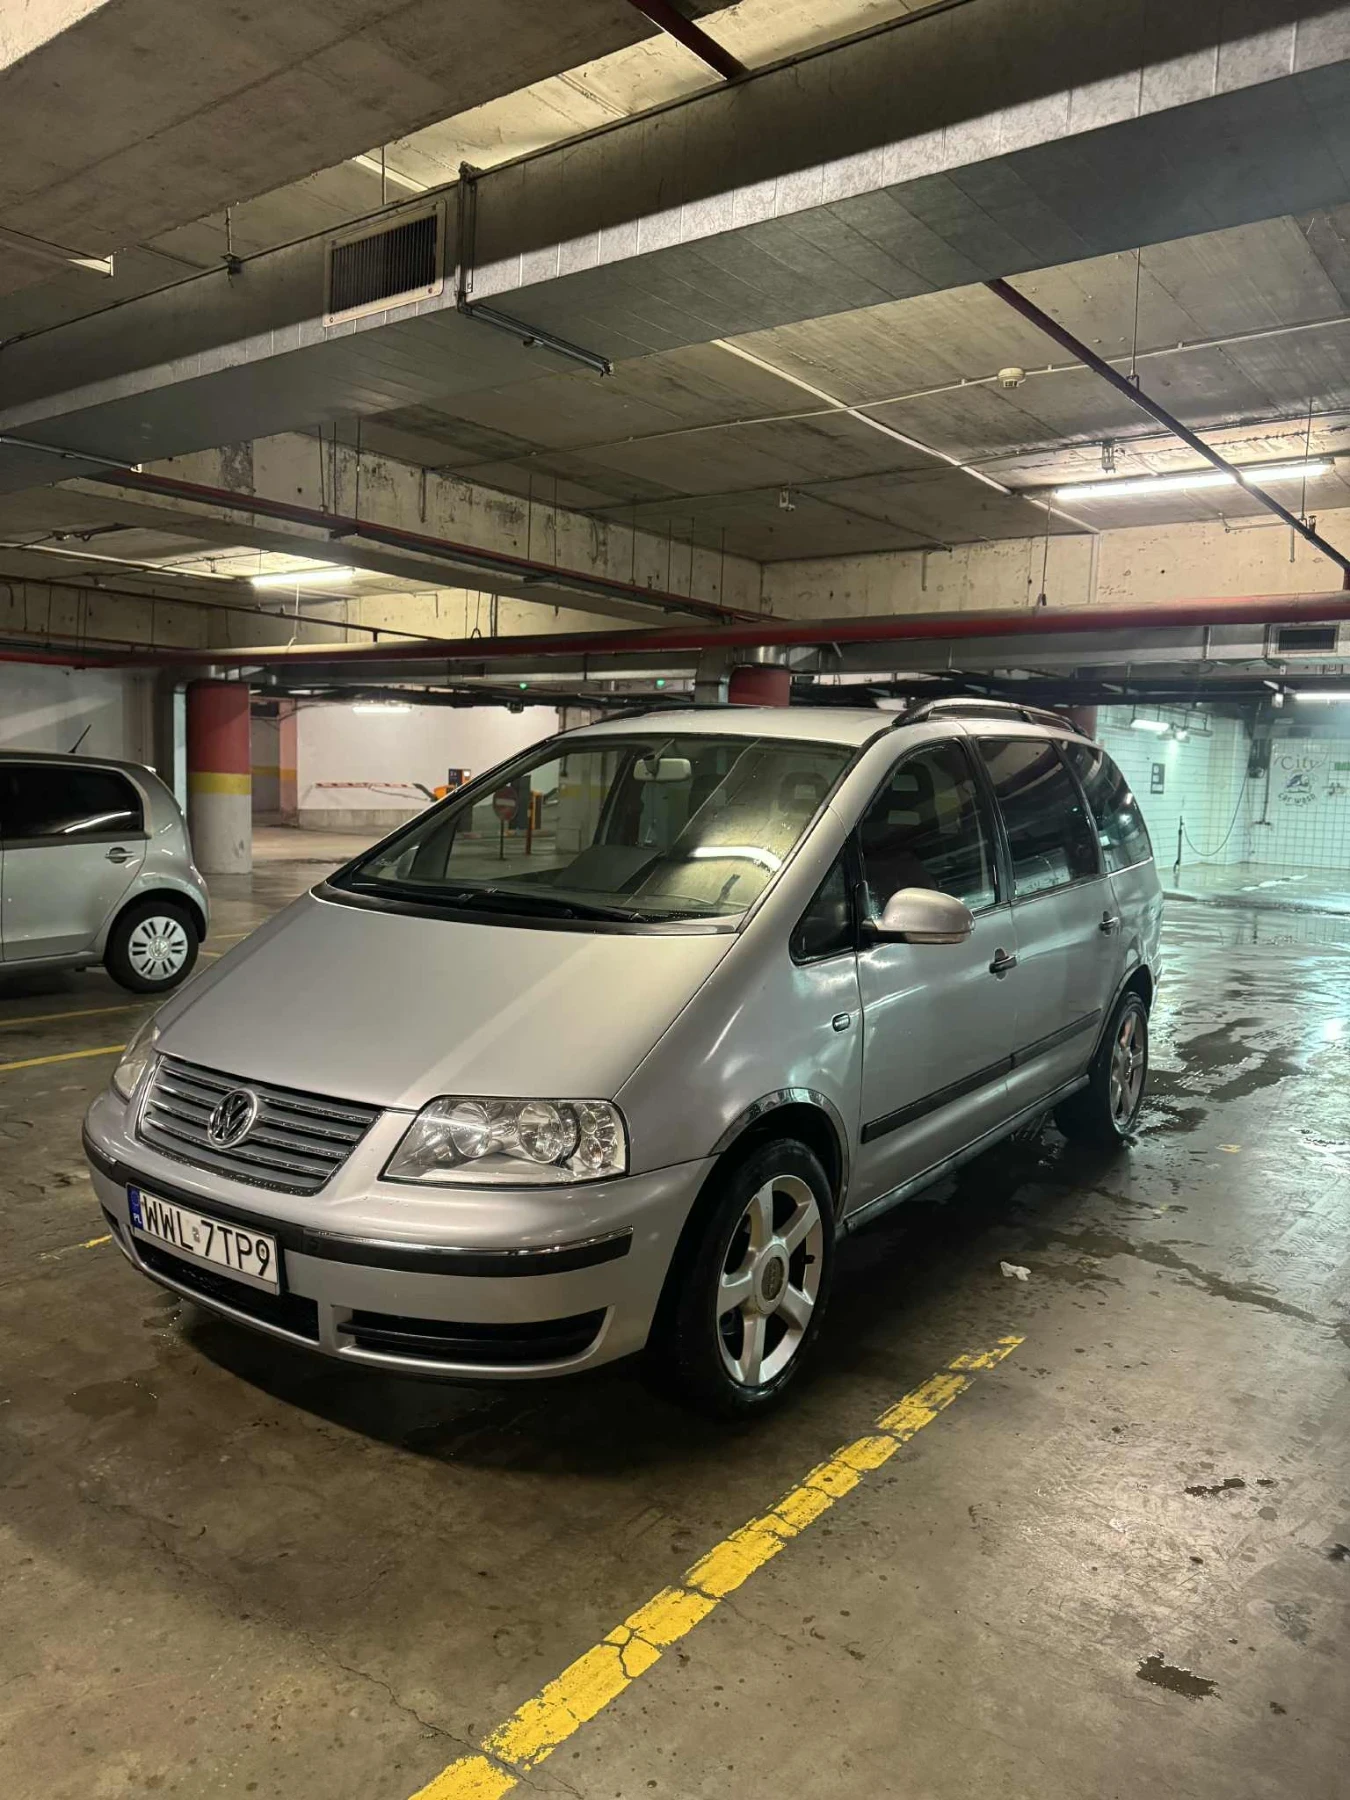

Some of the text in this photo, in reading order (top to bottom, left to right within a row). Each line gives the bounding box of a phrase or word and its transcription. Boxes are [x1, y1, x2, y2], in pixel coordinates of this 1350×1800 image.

[1281, 754, 1320, 773] City
[133, 1212, 143, 1225] PL
[143, 1195, 270, 1276] WWL 7TP9
